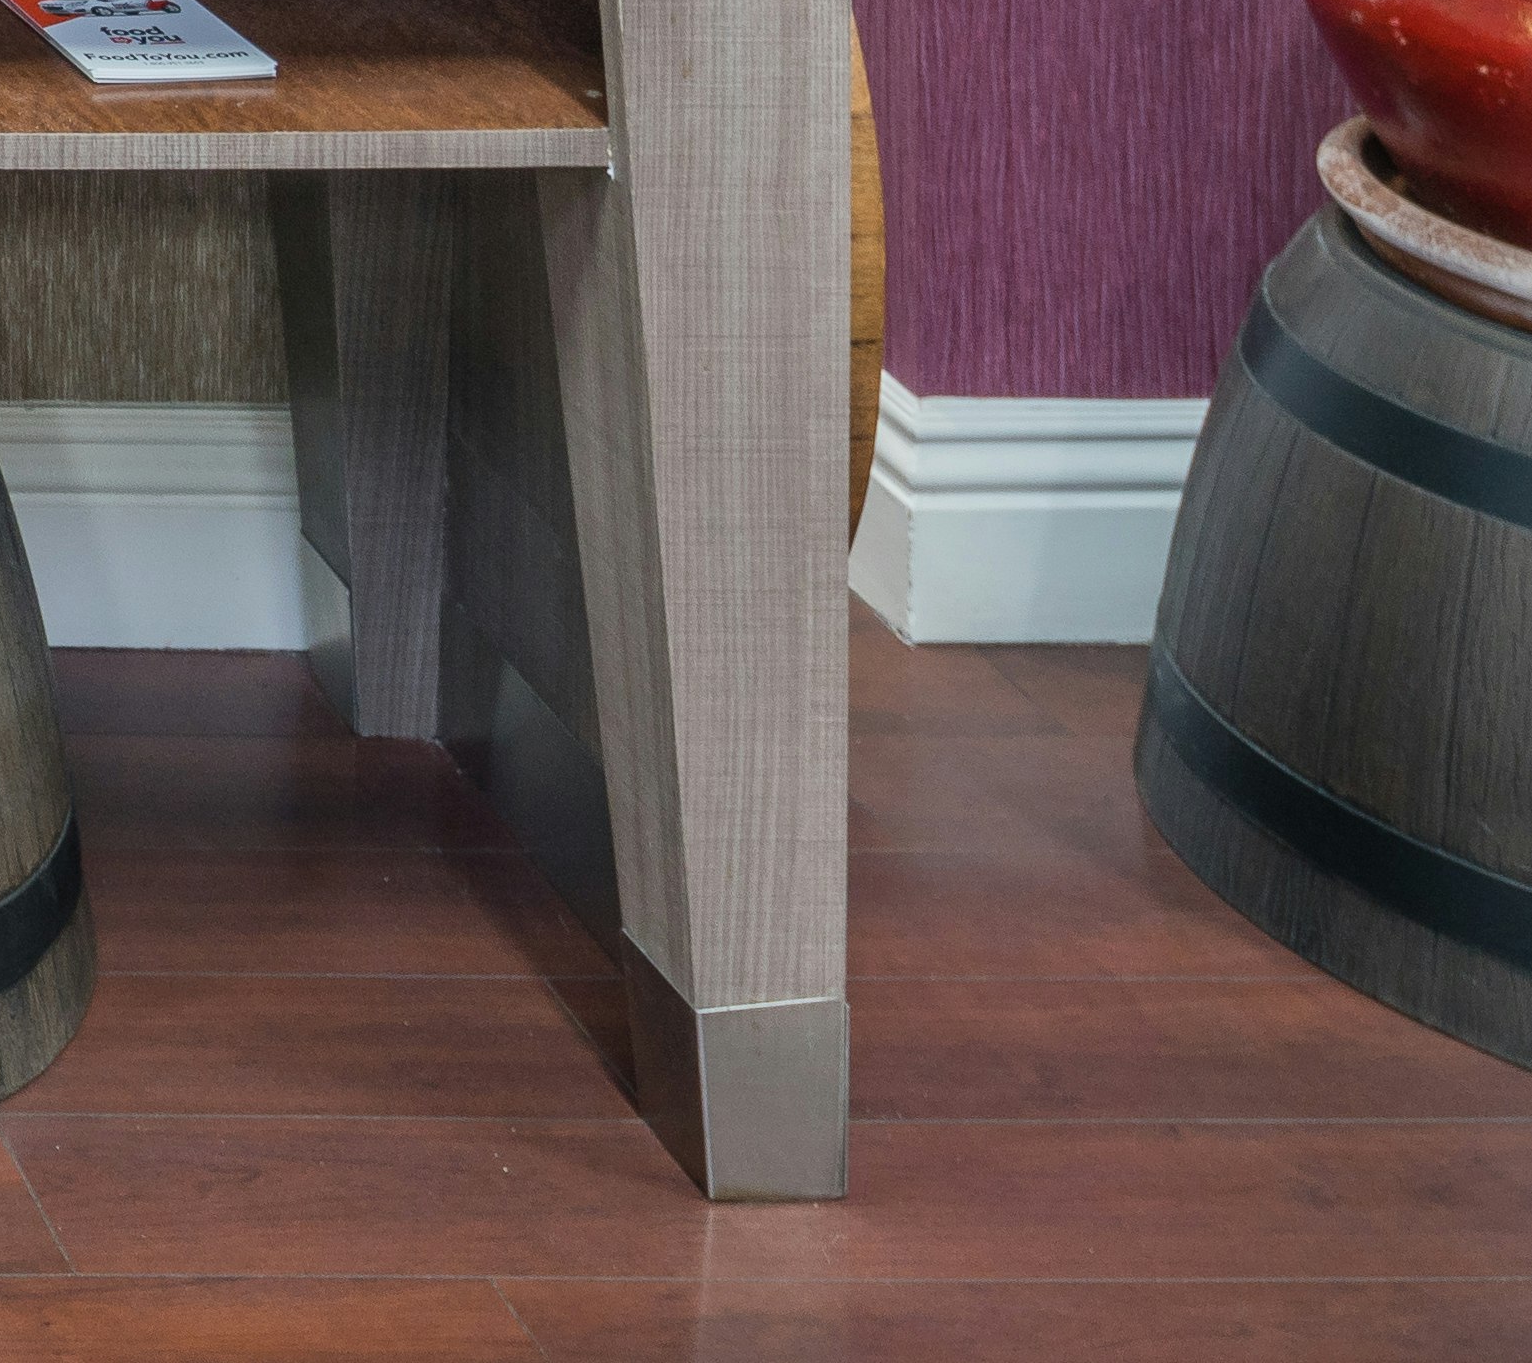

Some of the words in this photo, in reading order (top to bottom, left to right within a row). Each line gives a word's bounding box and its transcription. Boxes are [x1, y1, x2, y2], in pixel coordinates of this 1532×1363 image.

[100, 25, 167, 37] food
[137, 35, 183, 45] you
[84, 48, 249, 61] FoodToYou.com
